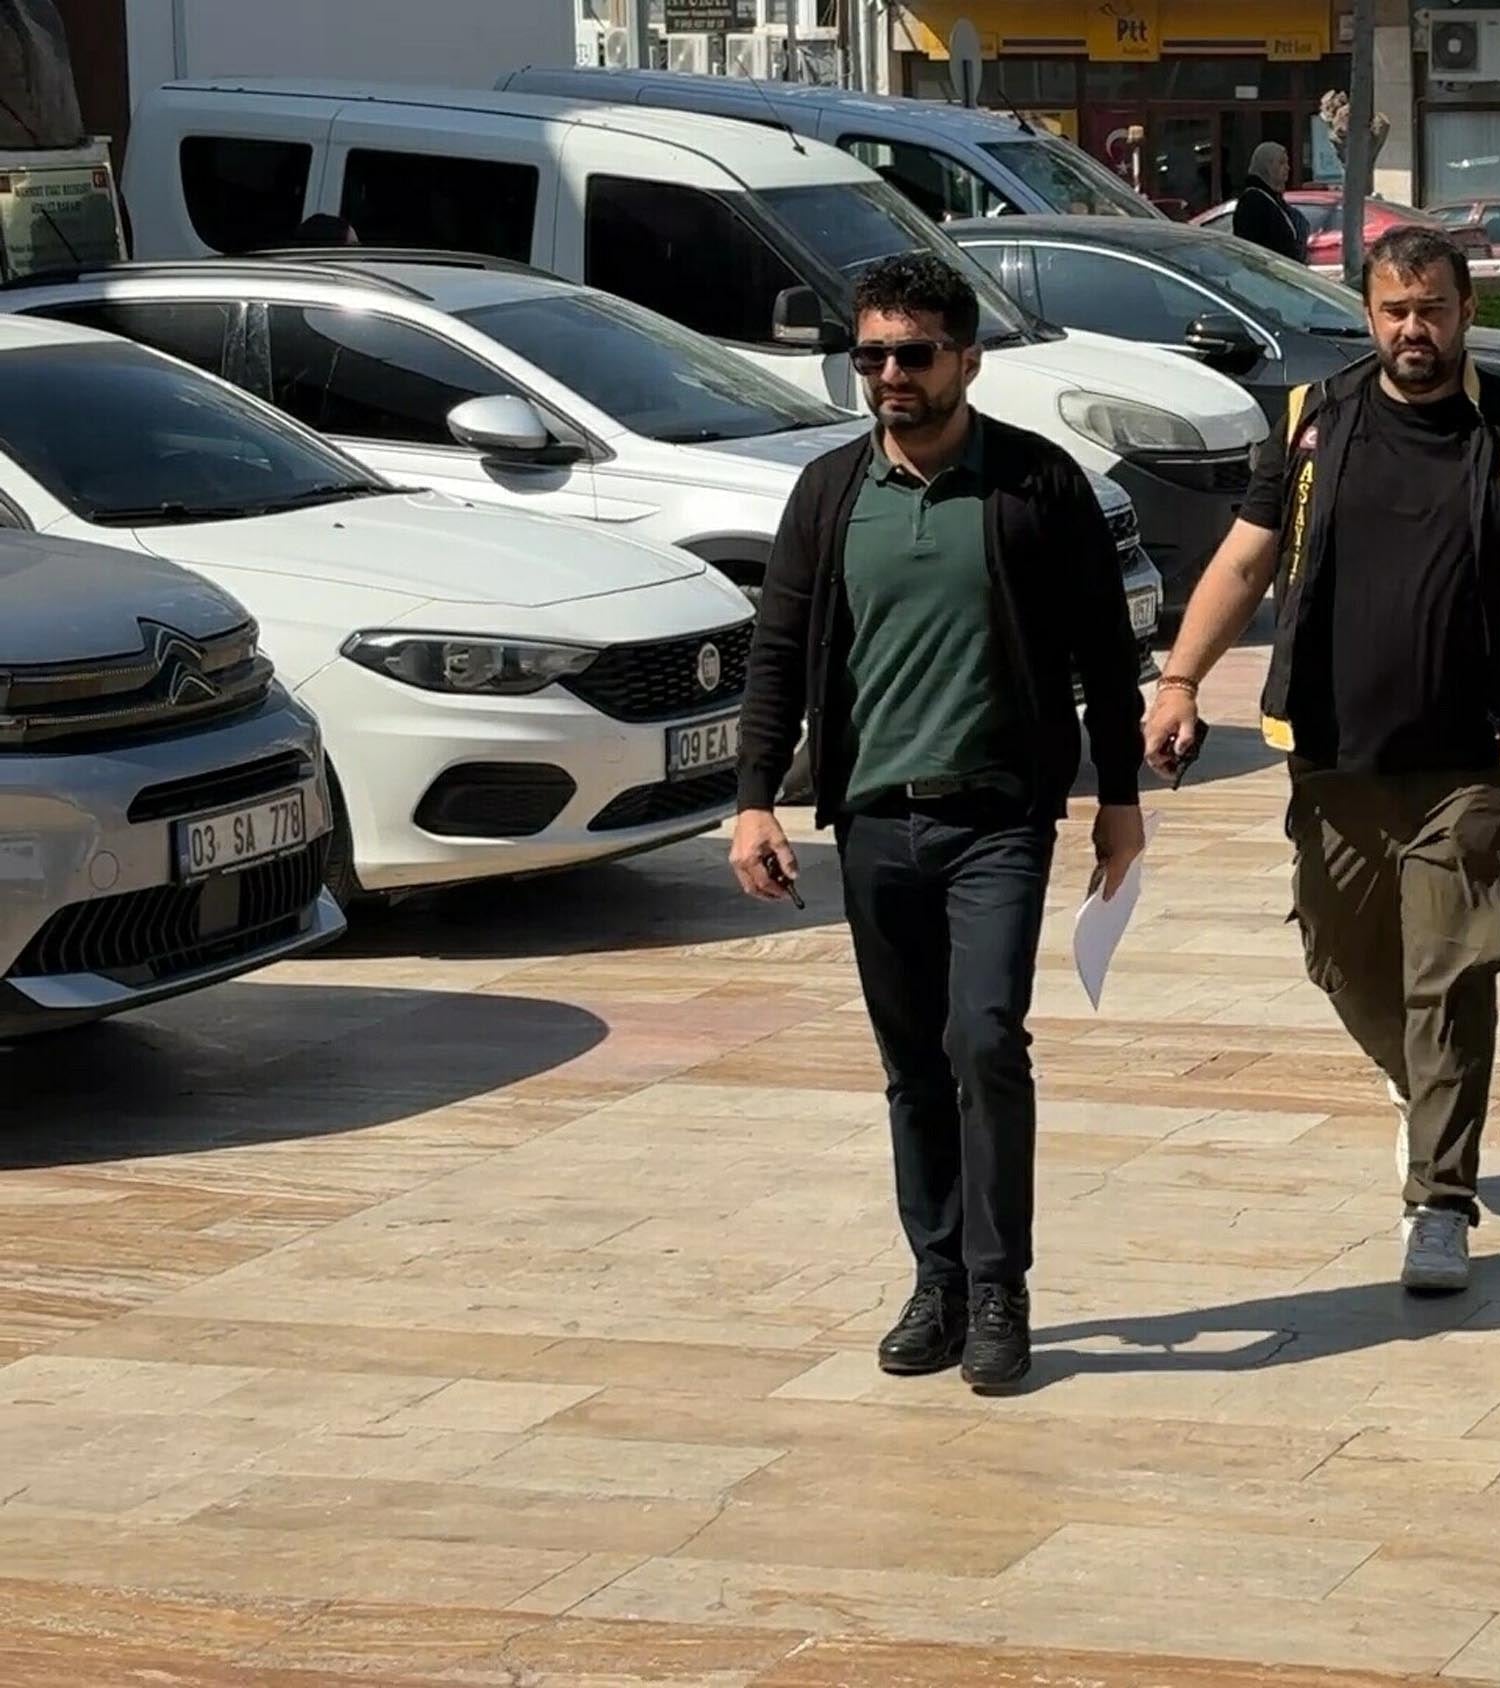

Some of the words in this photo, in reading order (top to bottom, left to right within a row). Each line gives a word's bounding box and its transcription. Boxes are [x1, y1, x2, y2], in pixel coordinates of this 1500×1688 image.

[1117, 18, 1148, 43] Ptt
[680, 730, 701, 766] 09
[705, 723, 729, 761] EA
[191, 824, 217, 867] 03
[233, 813, 256, 855] SA
[269, 801, 301, 845] 778
